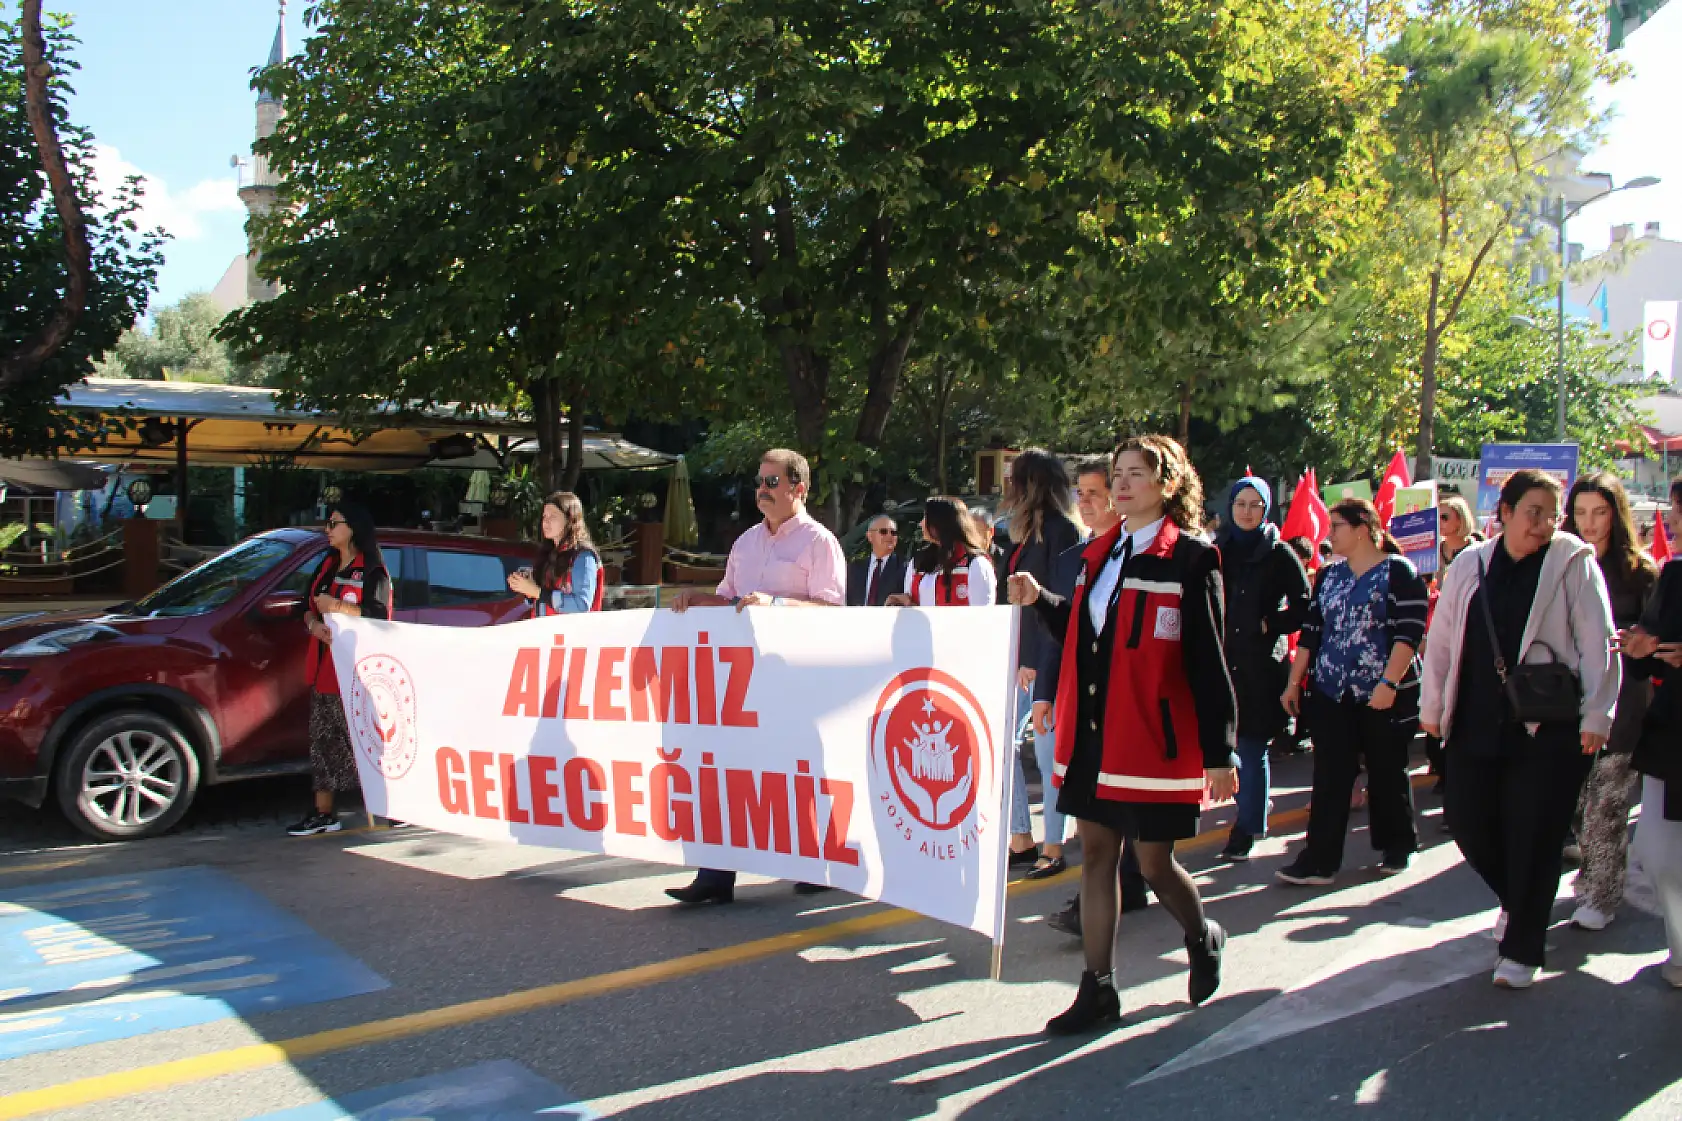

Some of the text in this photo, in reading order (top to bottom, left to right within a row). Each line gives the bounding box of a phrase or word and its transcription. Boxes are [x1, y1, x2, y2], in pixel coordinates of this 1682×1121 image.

[502, 631, 758, 727] AİLEMİZ
[435, 746, 859, 866] GELECEĞİMİZ
[880, 791, 912, 841] 2025
[919, 840, 956, 860] AİLE
